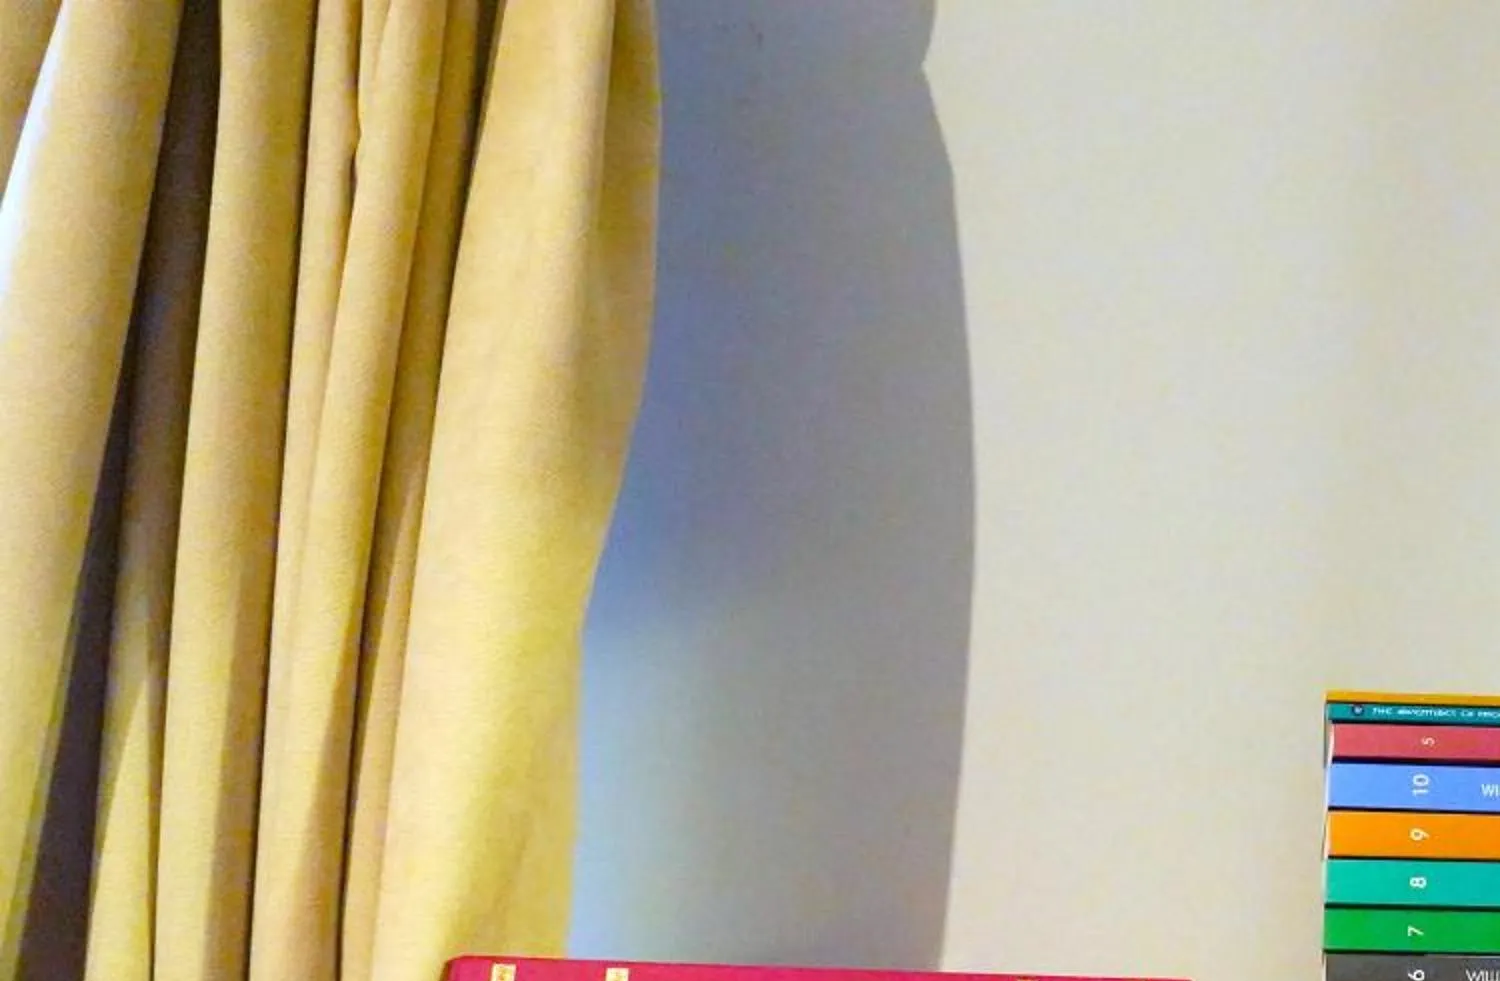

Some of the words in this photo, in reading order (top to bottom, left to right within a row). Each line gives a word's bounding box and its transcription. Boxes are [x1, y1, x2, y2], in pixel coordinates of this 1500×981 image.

[1412, 773, 1430, 795] 10
[1409, 828, 1430, 841] 9
[1409, 876, 1427, 889] 8
[1408, 925, 1424, 937] 7
[1408, 969, 1425, 981] 6
